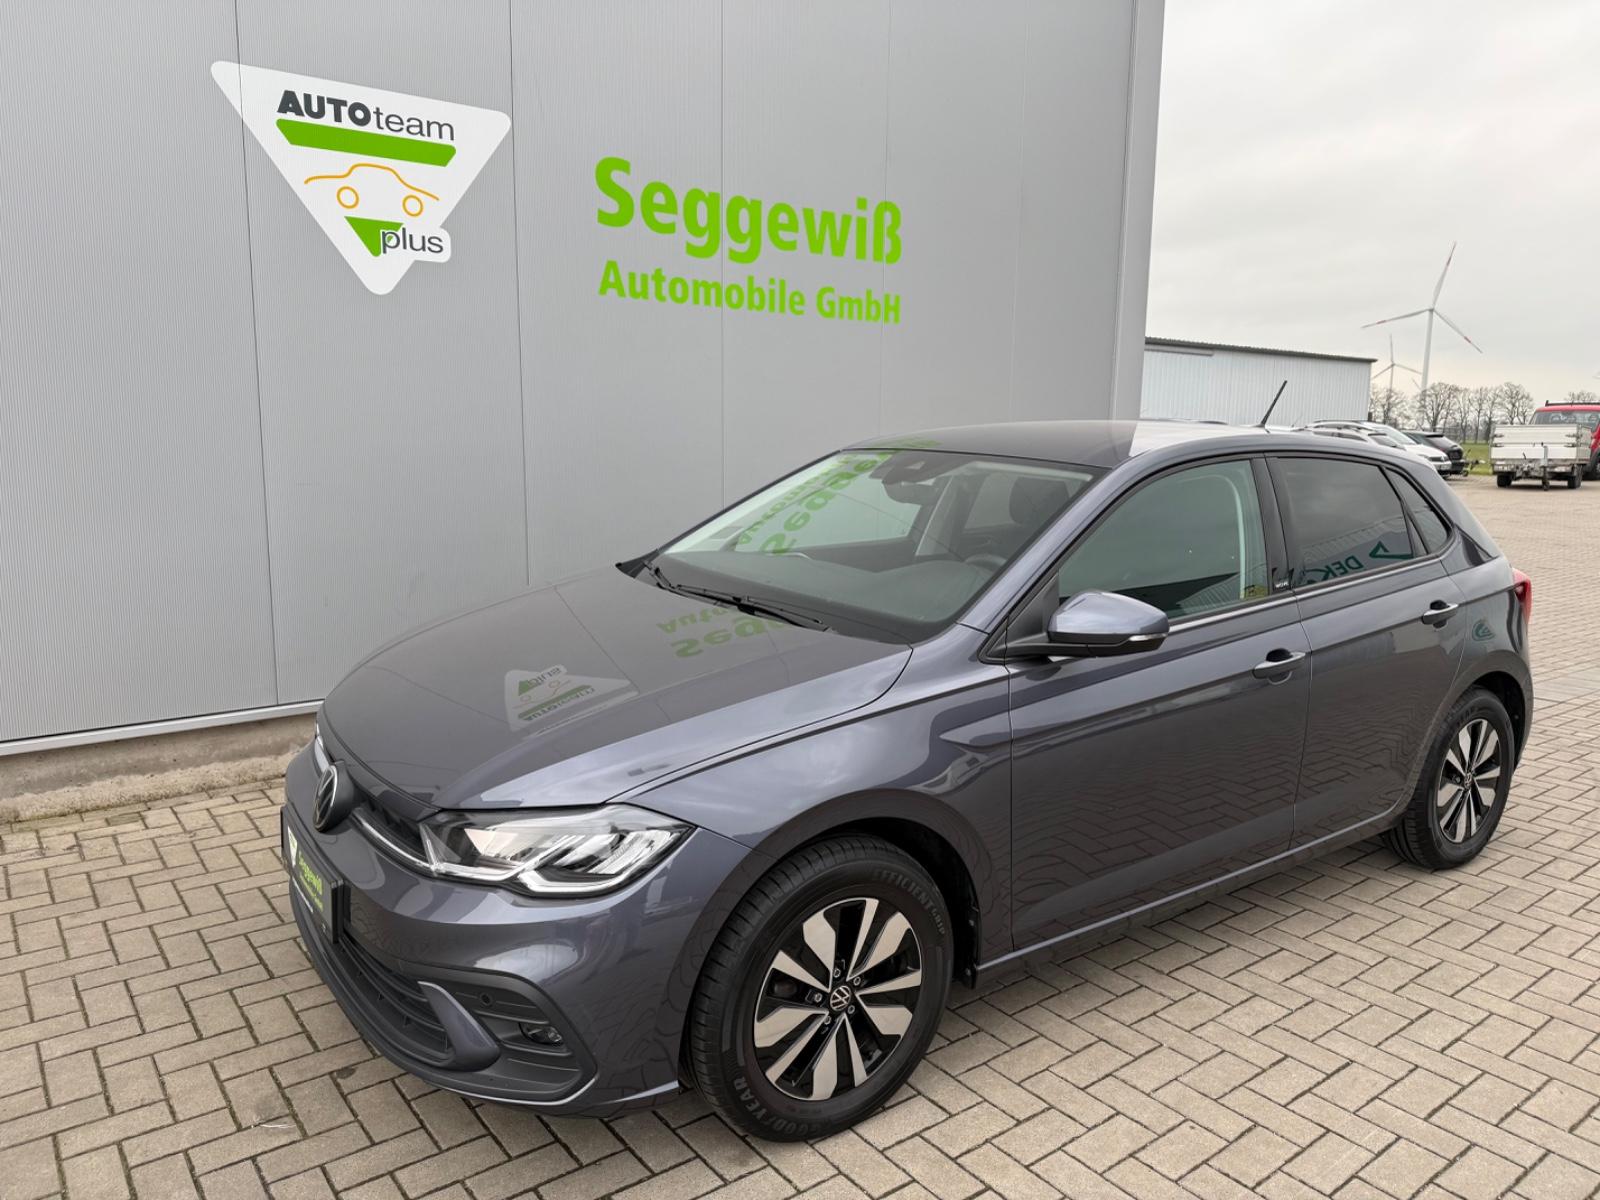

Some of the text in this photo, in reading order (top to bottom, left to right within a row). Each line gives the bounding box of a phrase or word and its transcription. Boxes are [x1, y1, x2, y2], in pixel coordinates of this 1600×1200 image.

[276, 89, 455, 141] AUTOteam
[381, 227, 444, 254] plus
[594, 156, 903, 266] Seggewiß
[597, 259, 902, 325] Automobile GmbH
